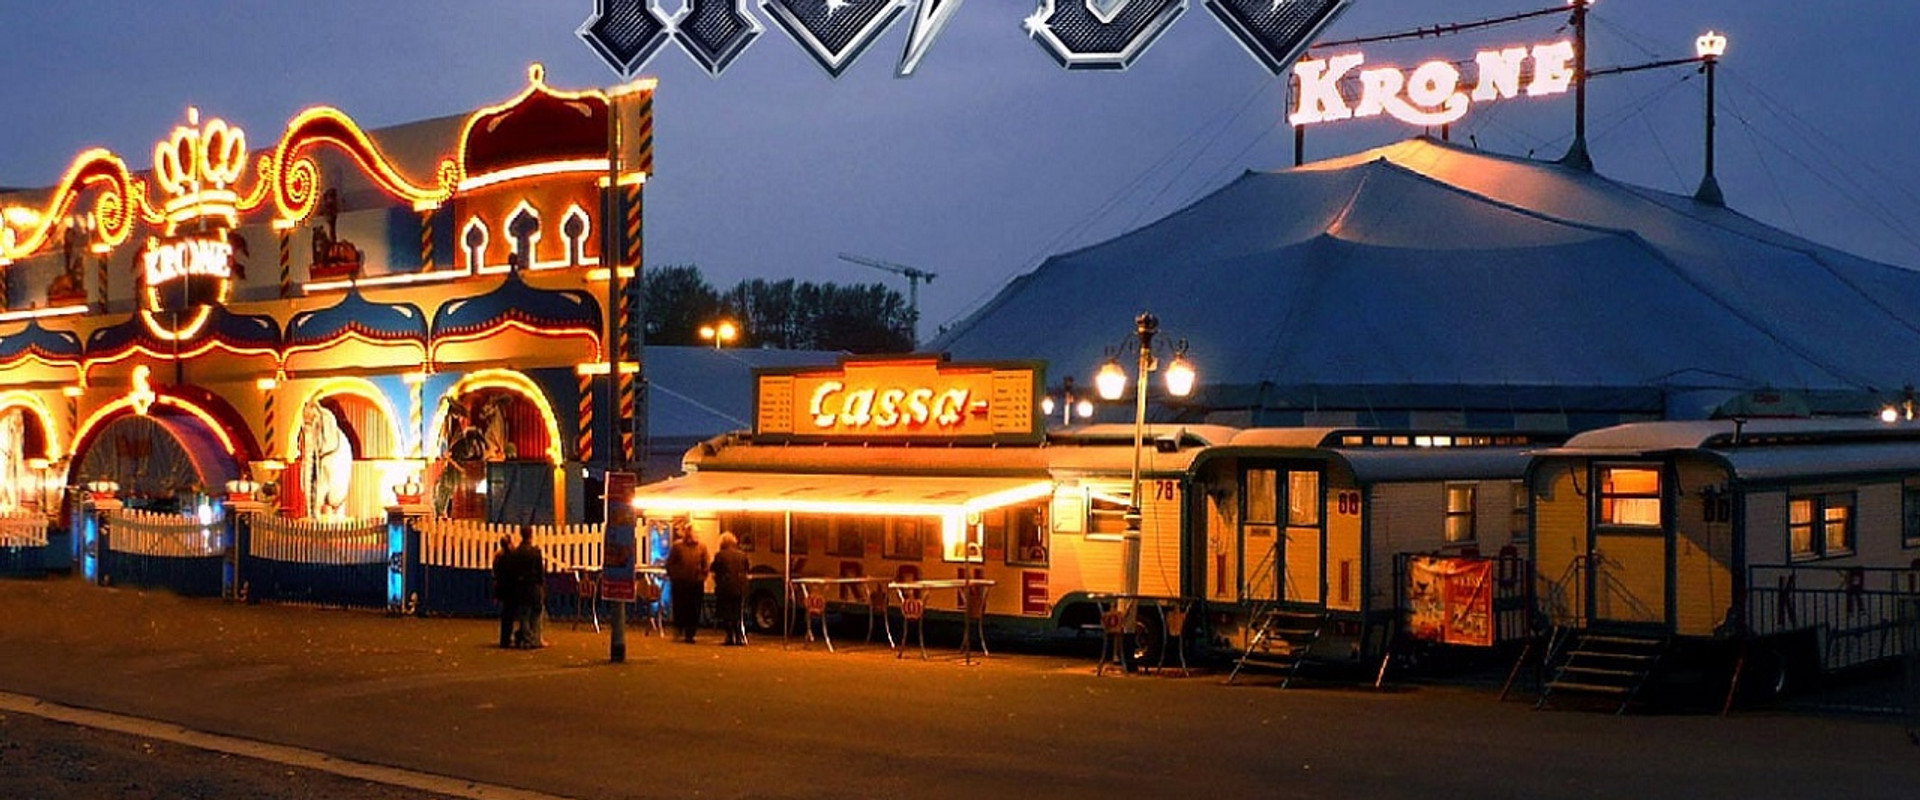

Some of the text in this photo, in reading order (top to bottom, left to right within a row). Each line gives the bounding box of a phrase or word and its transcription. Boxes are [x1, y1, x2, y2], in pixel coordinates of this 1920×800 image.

[1290, 41, 1574, 127] KRONE
[144, 239, 233, 286] KRONE
[1156, 480, 1173, 500] 78
